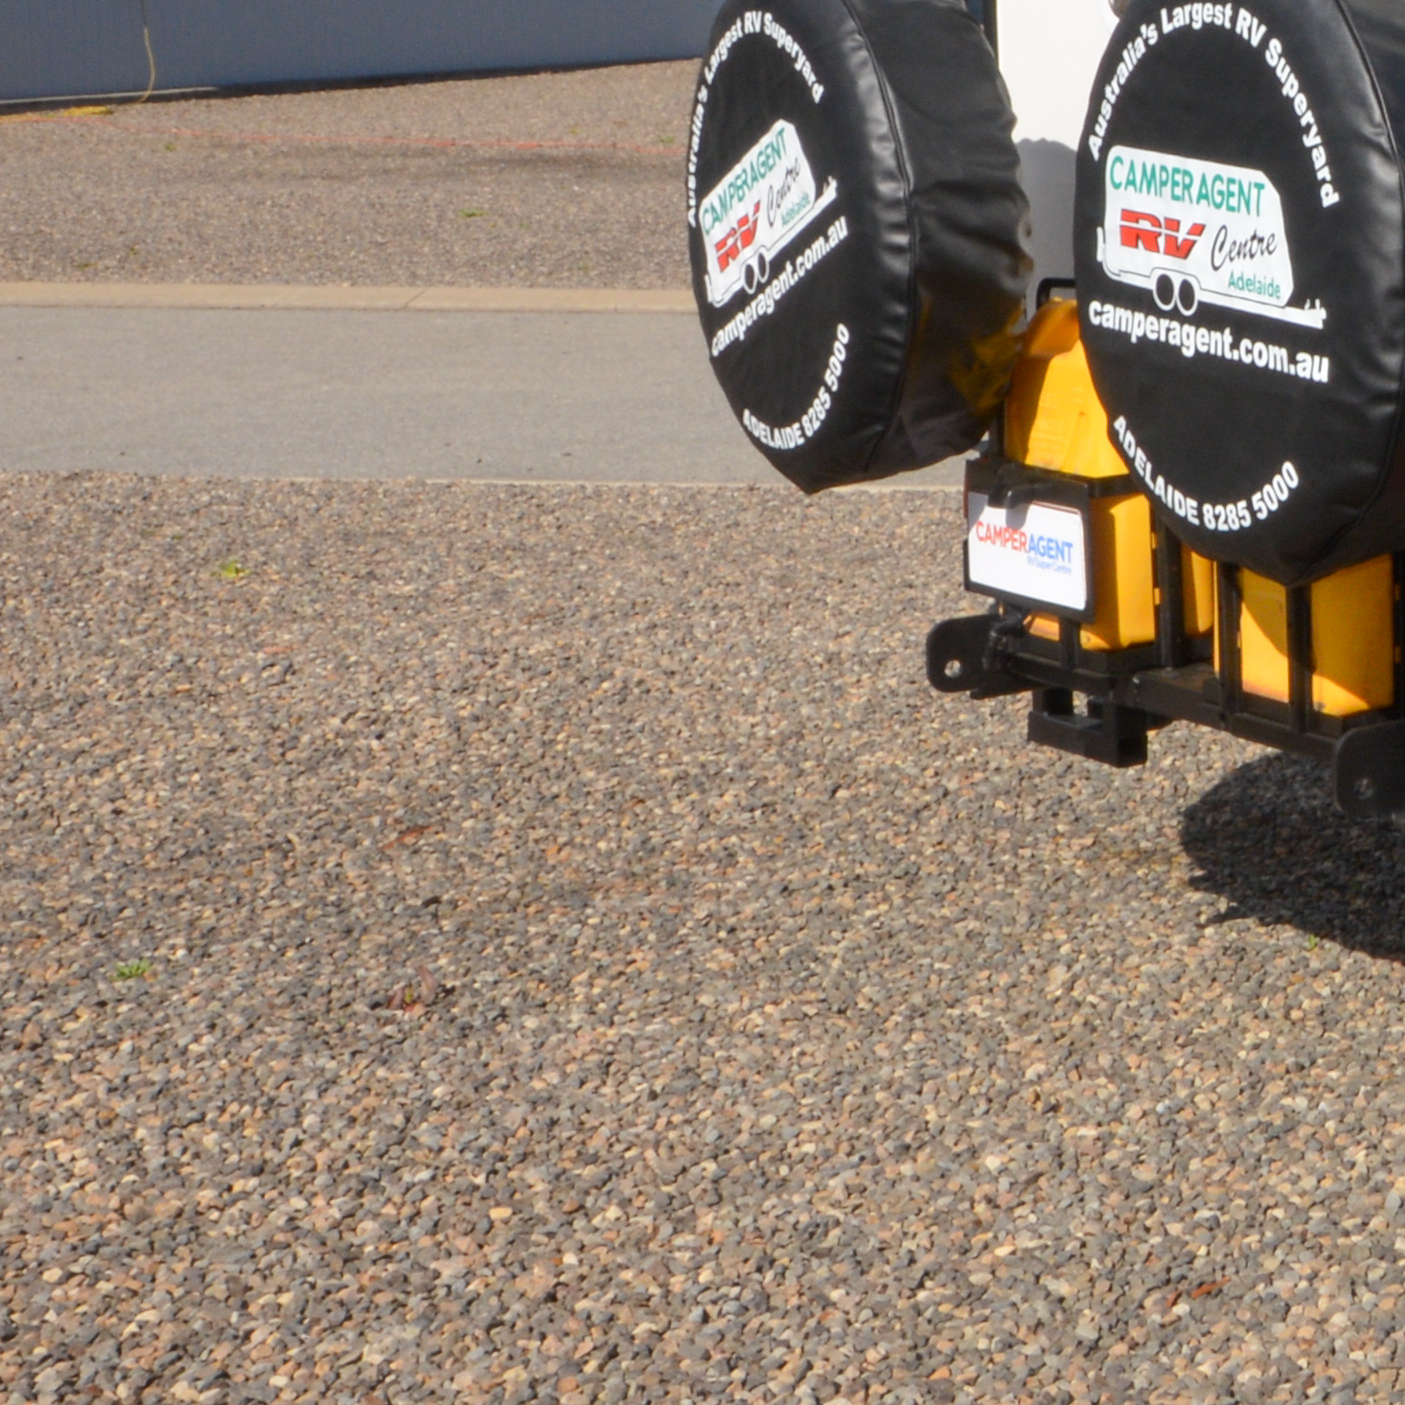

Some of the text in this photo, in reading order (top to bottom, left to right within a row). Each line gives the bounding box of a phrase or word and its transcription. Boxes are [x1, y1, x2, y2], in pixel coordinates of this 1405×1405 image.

[704, 17, 743, 85] Largest
[744, 10, 762, 34] RV
[764, 12, 825, 104] Superyard
[1088, 2, 1340, 208] Australia's Largest RV Superyard
[714, 157, 800, 273] RV Centre
[1119, 208, 1277, 271] RV Centre
[711, 215, 848, 357] camperagent.com.au
[1228, 270, 1281, 300] Adelaide
[743, 323, 850, 449] ADELAIDE 8285 5000
[1088, 300, 1329, 383] camperagent.com.au
[1113, 414, 1299, 532] ADELAIDE 8285 5000
[976, 521, 1073, 564] CAMPERAGENT
